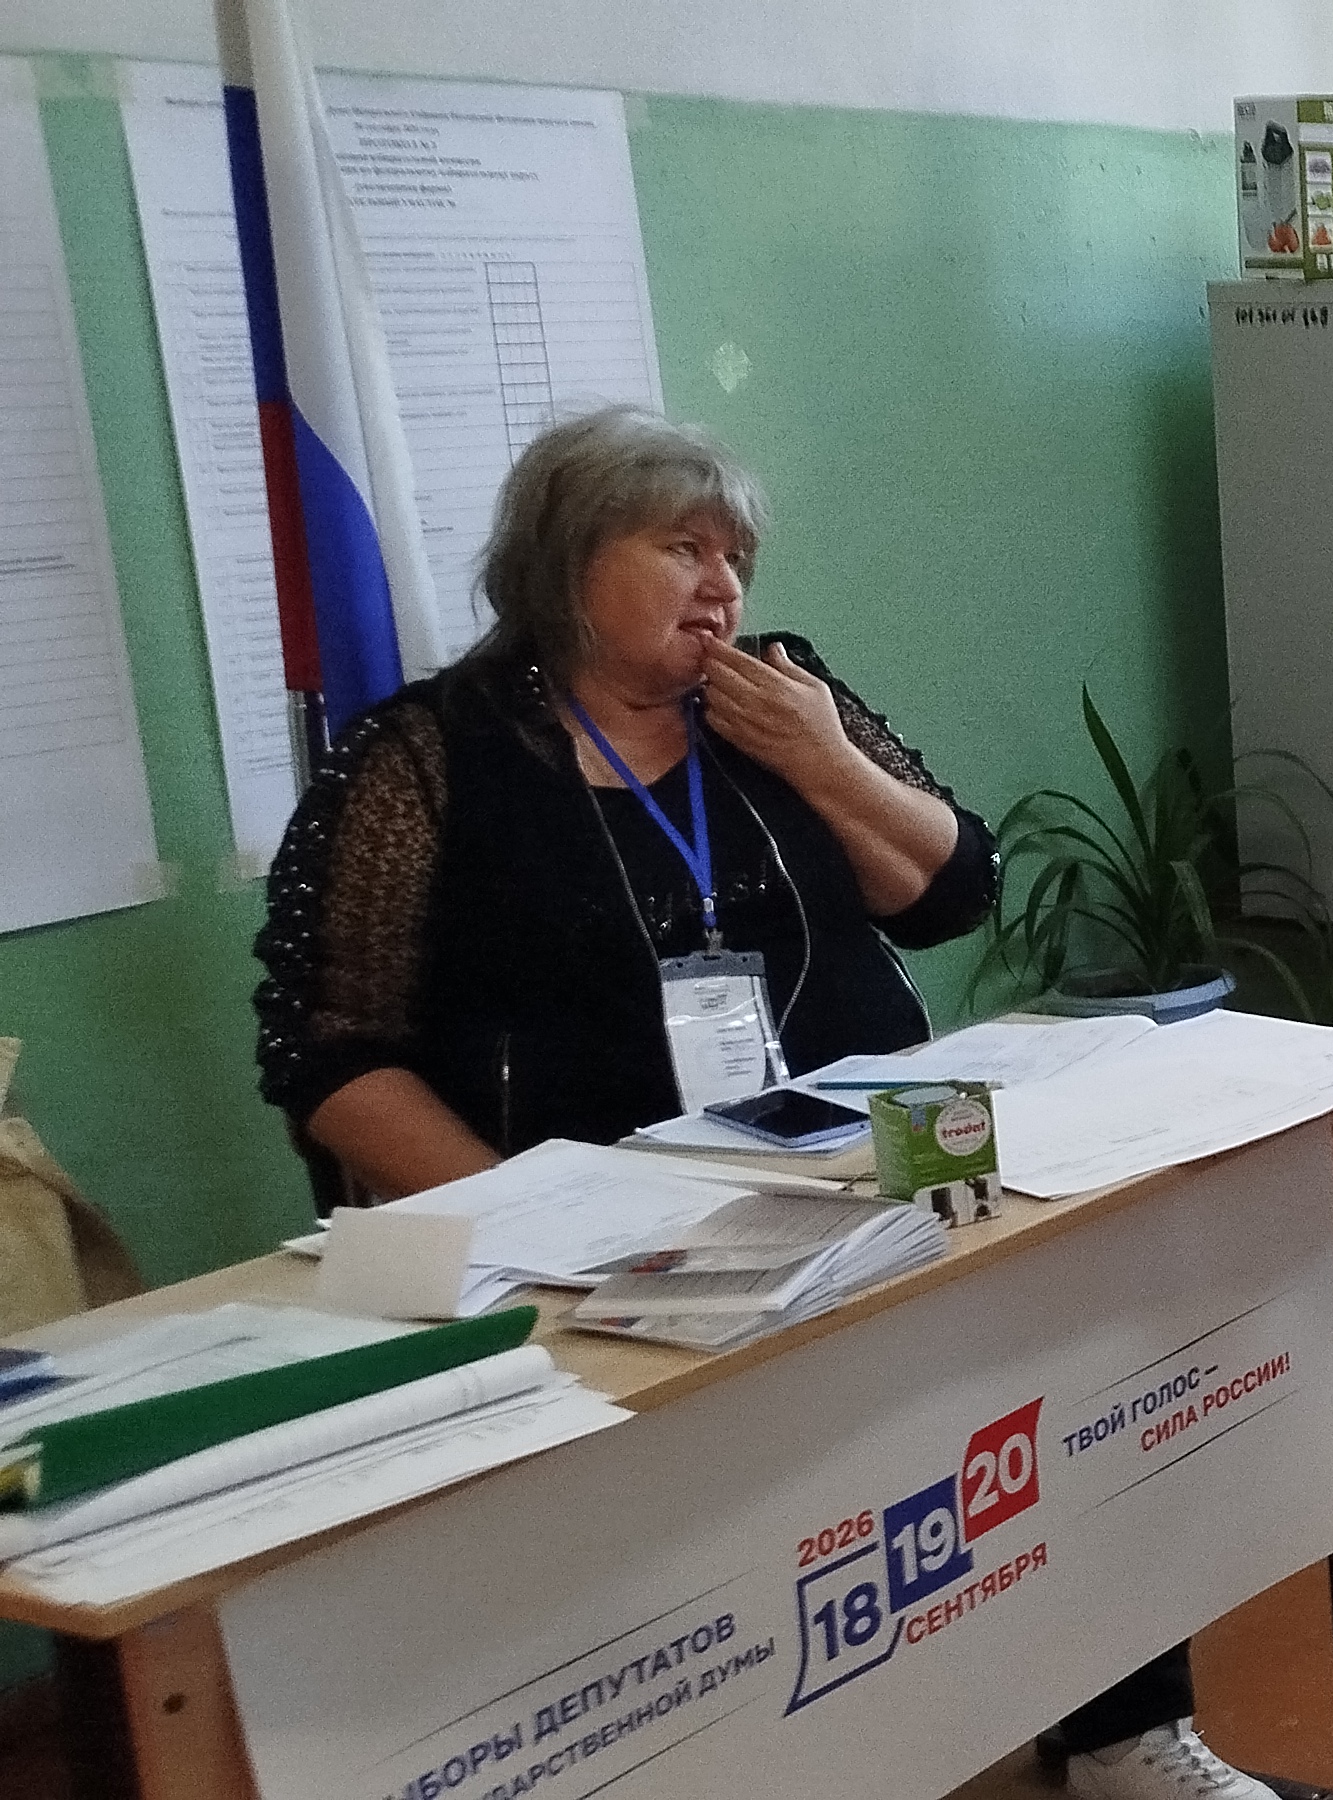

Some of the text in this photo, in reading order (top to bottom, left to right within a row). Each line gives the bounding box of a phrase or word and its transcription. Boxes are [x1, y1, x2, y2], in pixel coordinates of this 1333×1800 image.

[1062, 1401, 1126, 1458] ТВОЙ
[1131, 1367, 1201, 1421] ГОЛОС
[1140, 1352, 1292, 1453] СИЛА РОССИИ!
[965, 1431, 1034, 1519] 20
[796, 1509, 875, 1568] 2026
[891, 1506, 956, 1588] 19
[813, 1581, 882, 1662] 18
[905, 1542, 1048, 1645] СЕНТЯБРЯ
[534, 1613, 735, 1746] ДЕПУТАТОВ
[699, 1637, 777, 1699] ДУМЫ
